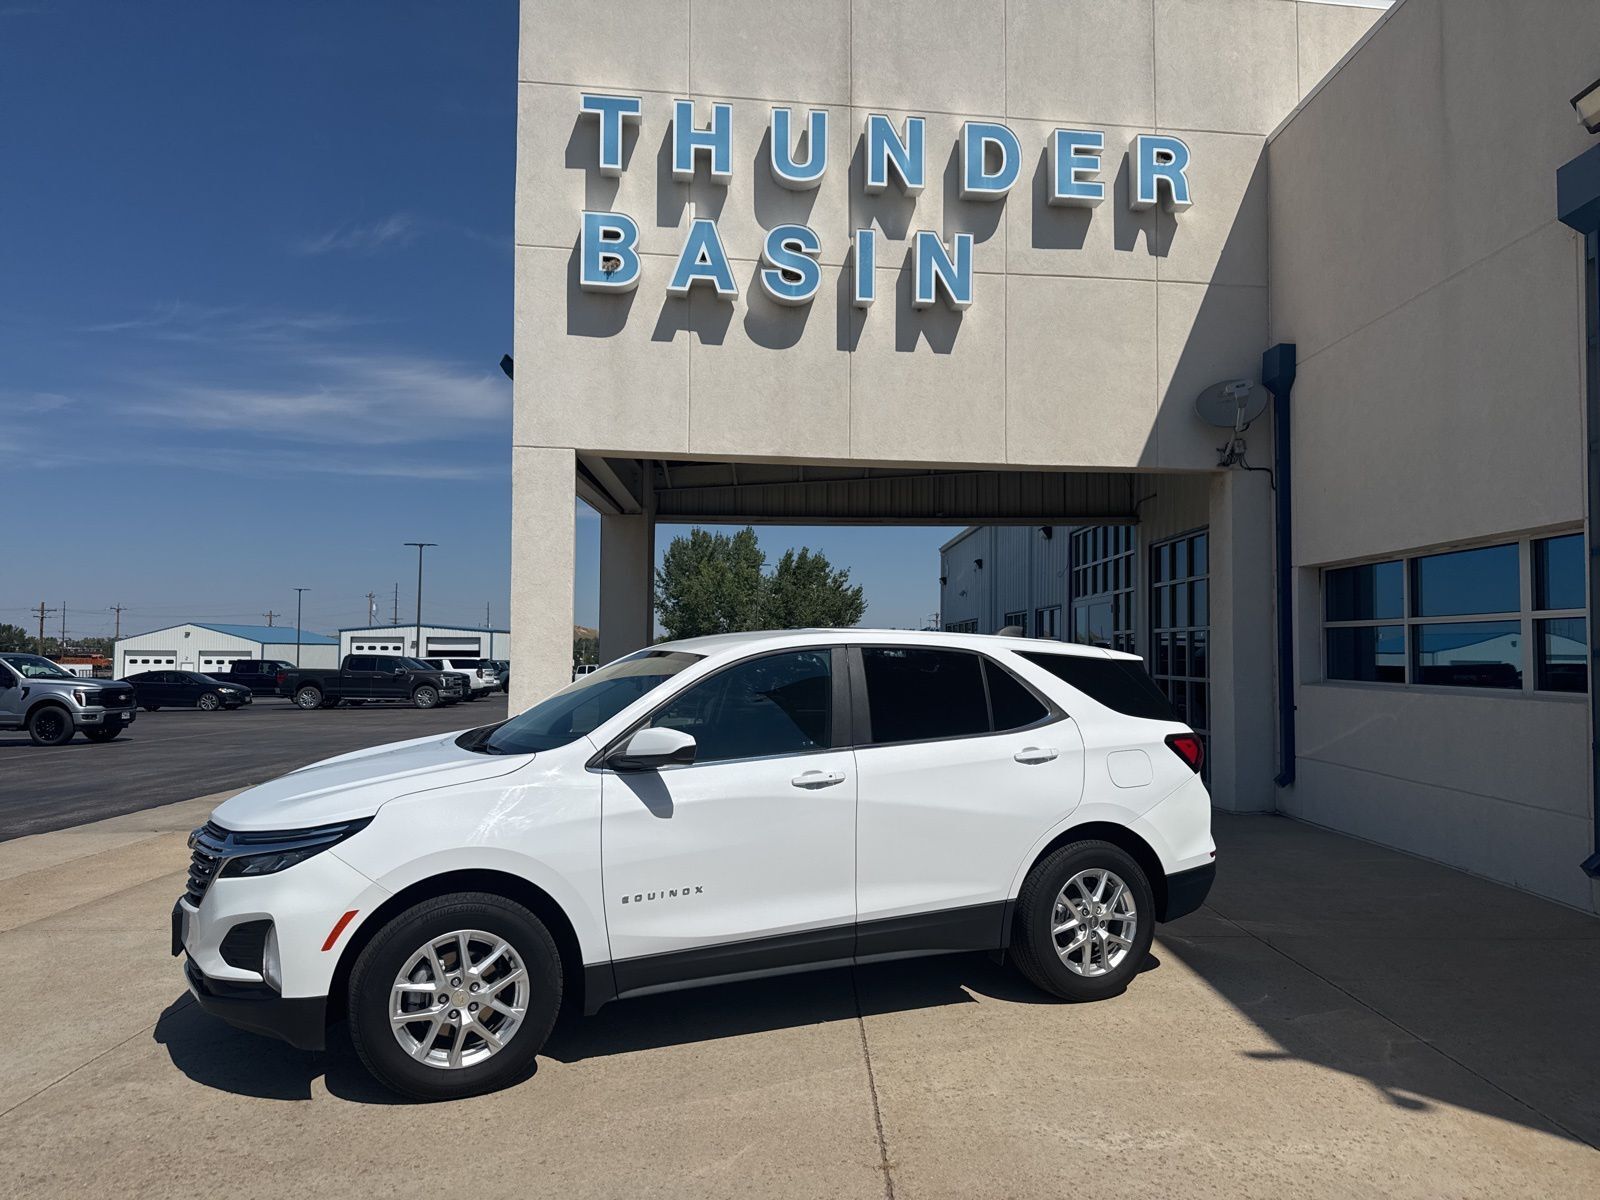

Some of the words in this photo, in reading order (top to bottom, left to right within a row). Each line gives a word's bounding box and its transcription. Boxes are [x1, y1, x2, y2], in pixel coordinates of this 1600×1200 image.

[580, 93, 1193, 211] THUNDER
[580, 211, 974, 309] BASIN
[621, 886, 704, 905] EQUINOX
